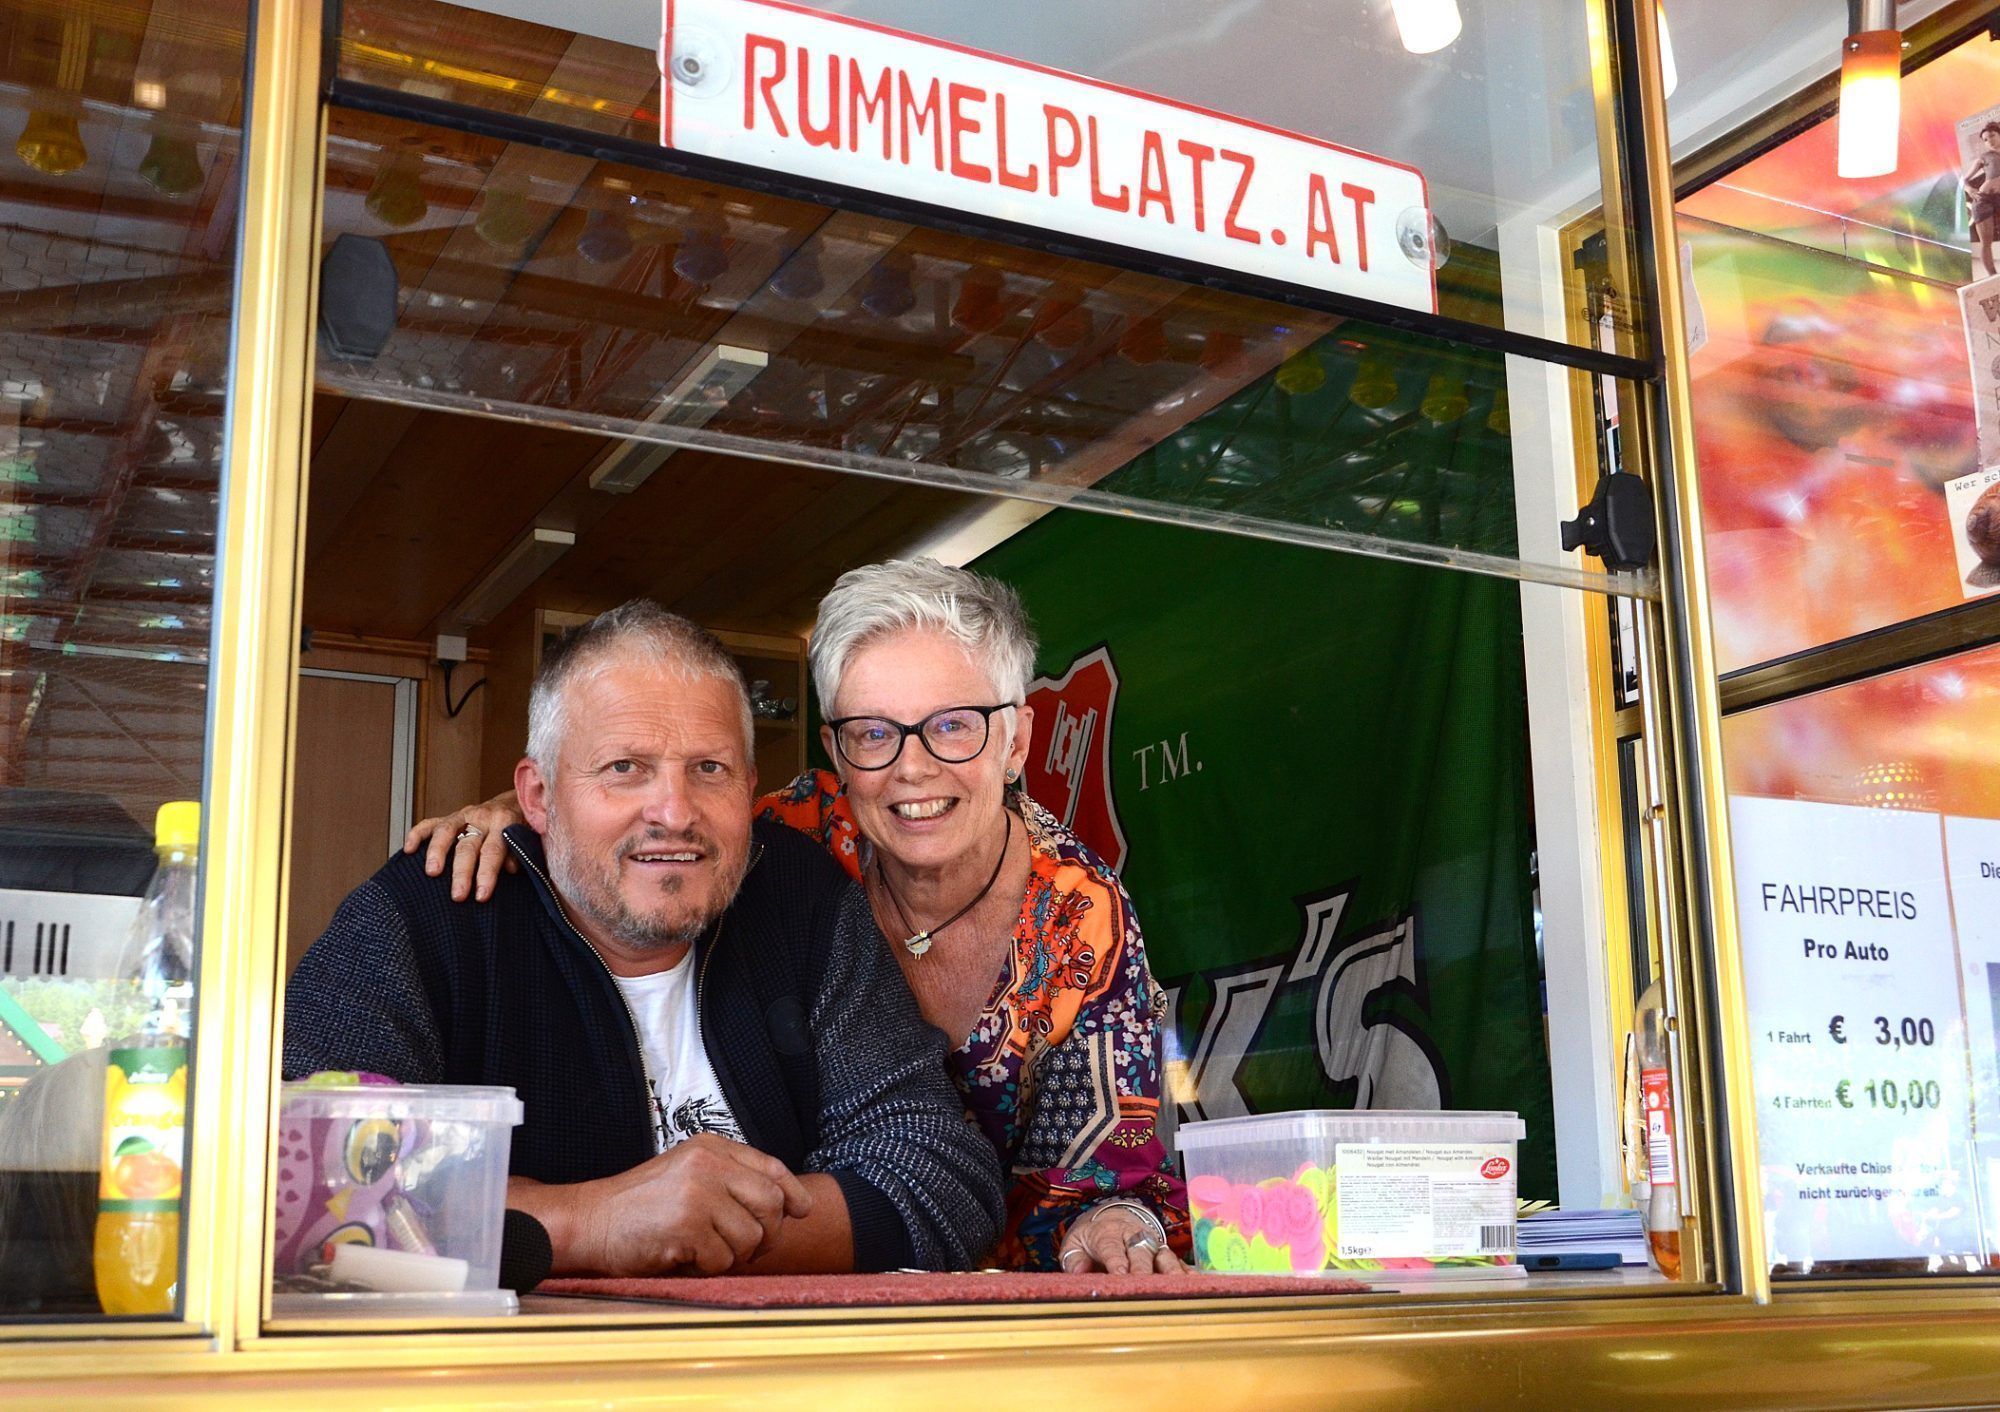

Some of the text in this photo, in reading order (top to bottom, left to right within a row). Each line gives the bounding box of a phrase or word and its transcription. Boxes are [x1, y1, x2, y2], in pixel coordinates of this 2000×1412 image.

[742, 33, 1376, 273] RUMMELPLATZ.AT
[1954, 479, 1977, 492] Wer
[1132, 732, 1204, 792] TM.
[1761, 882, 1918, 921] FAHRPREIS
[1803, 937, 1890, 962] Pro Auto
[1767, 1015, 1936, 1052] 1 Fahrt € 3,00
[1772, 1078, 1942, 1116] 4 Fahrten € 10,00
[1796, 1162, 1857, 1176] Verkaufte
[1860, 1162, 1893, 1177] Chips
[1799, 1186, 1832, 1200] nicht
